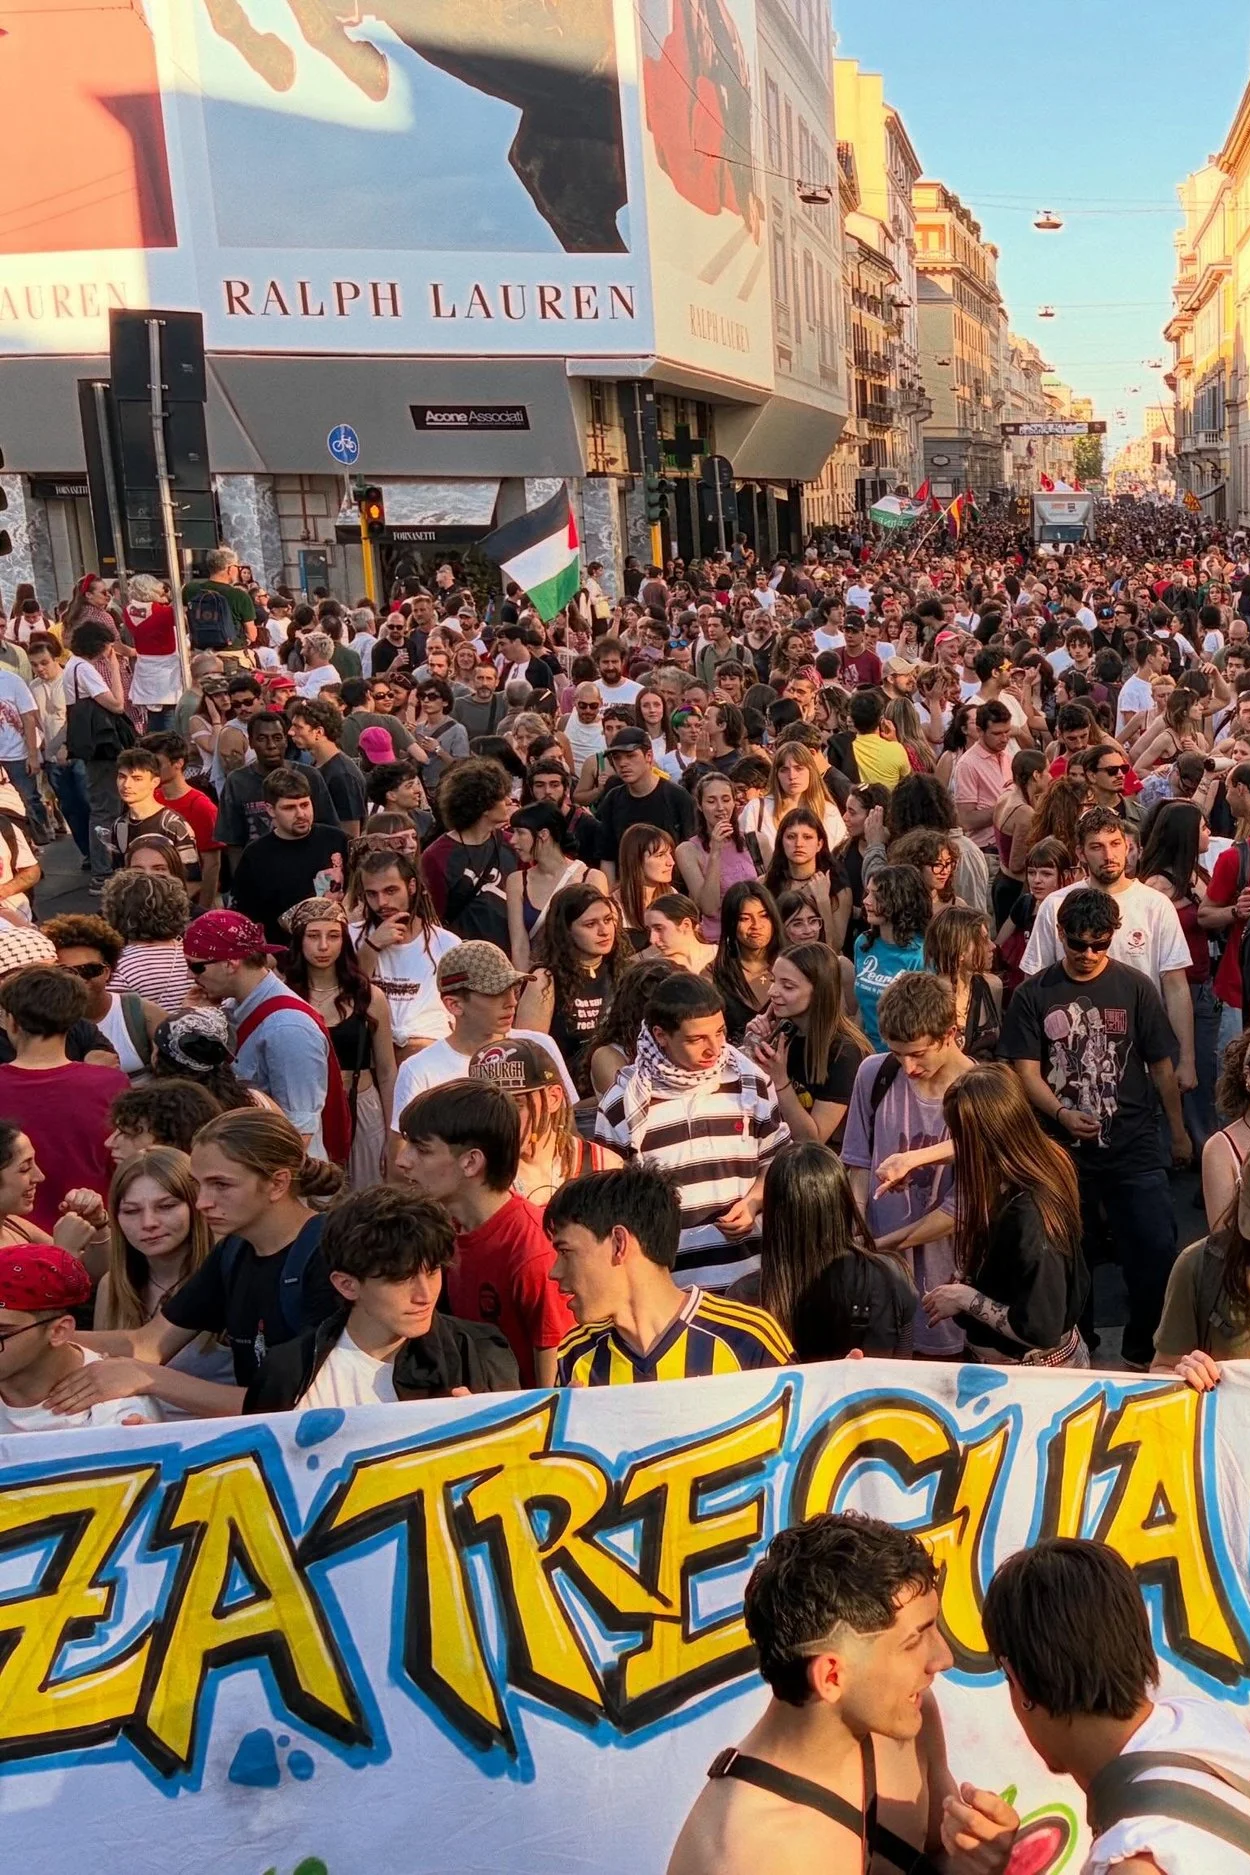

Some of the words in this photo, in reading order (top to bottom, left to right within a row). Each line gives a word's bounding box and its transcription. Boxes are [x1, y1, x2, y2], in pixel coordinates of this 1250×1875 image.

[222, 280, 401, 317] RALPH
[429, 283, 637, 320] LAUREN
[426, 405, 468, 422] Acone
[469, 405, 525, 422] Associati
[393, 531, 436, 541] FORNASETTI
